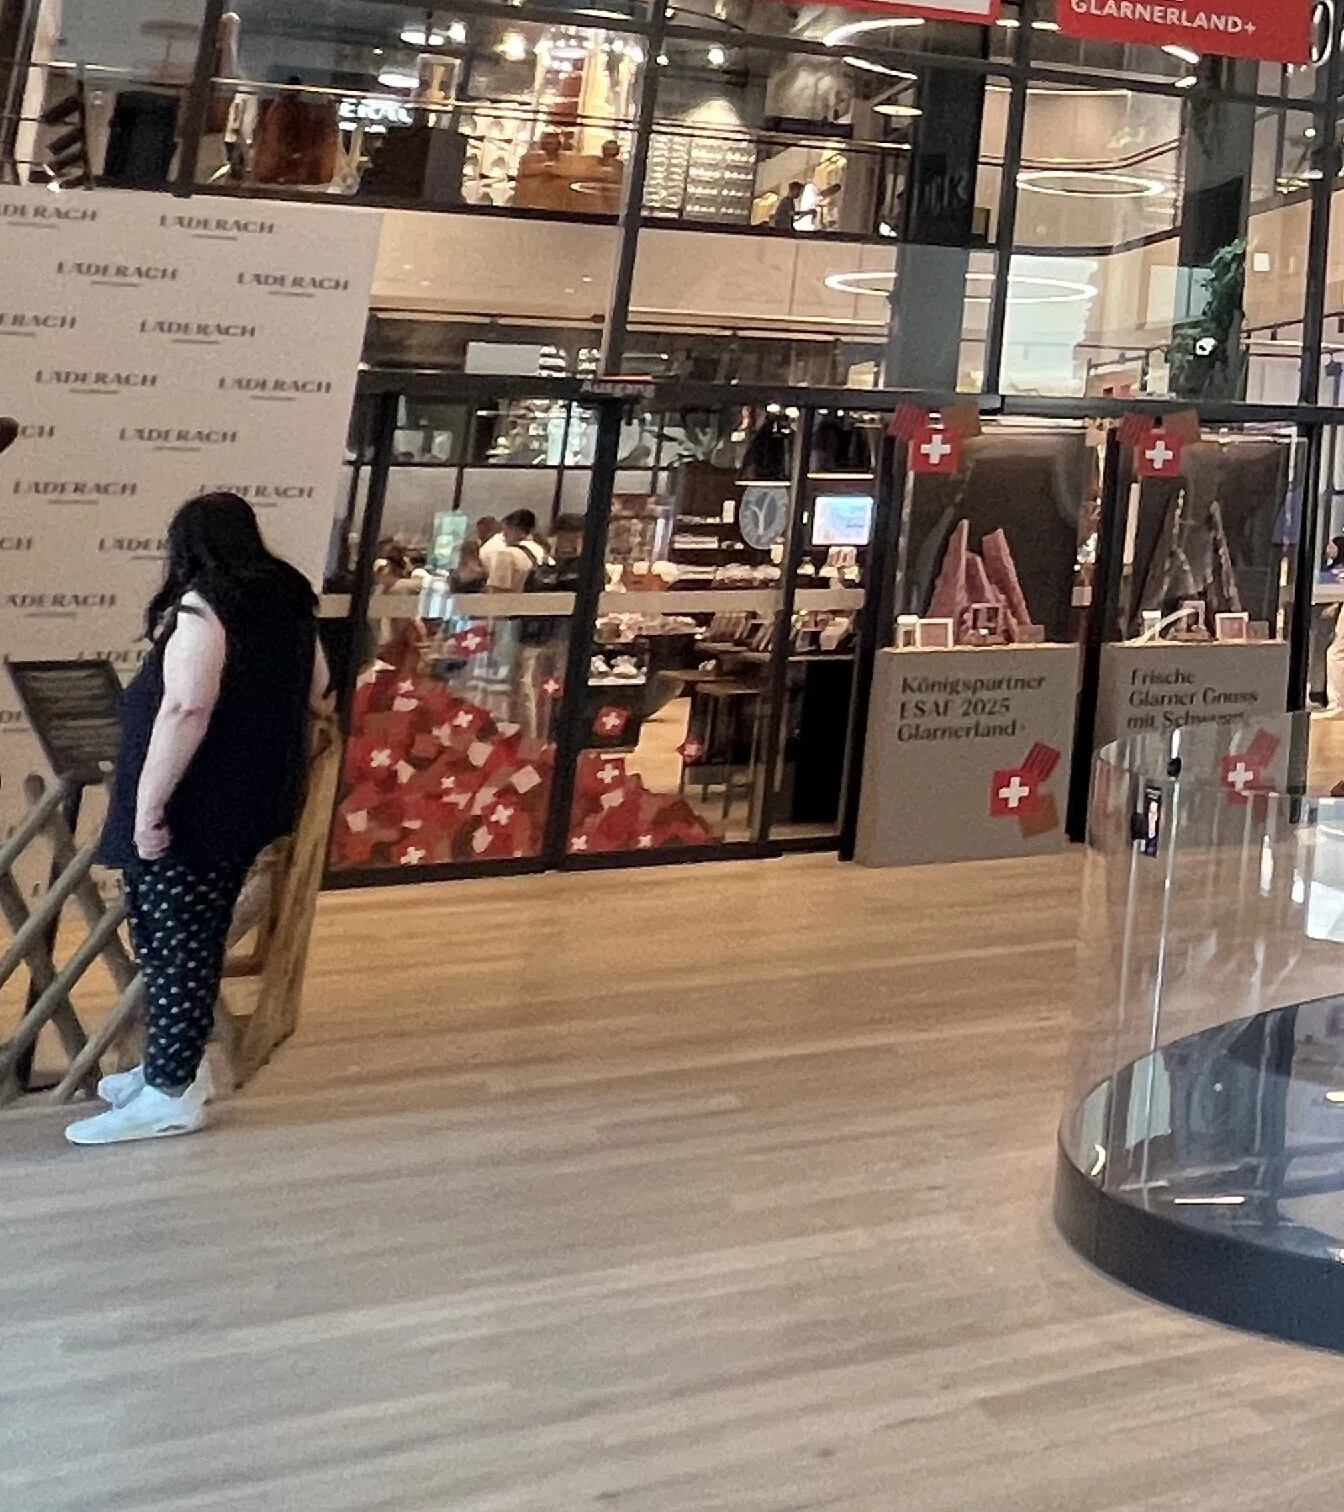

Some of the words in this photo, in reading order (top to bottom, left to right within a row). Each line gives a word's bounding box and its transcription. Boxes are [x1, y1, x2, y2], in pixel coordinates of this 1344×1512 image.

[902, 675, 1046, 696] Königspartner
[1131, 668, 1196, 686] Frische
[900, 698, 952, 719] ESAF
[961, 696, 1010, 717] 2025
[1129, 688, 1196, 707] Glarner
